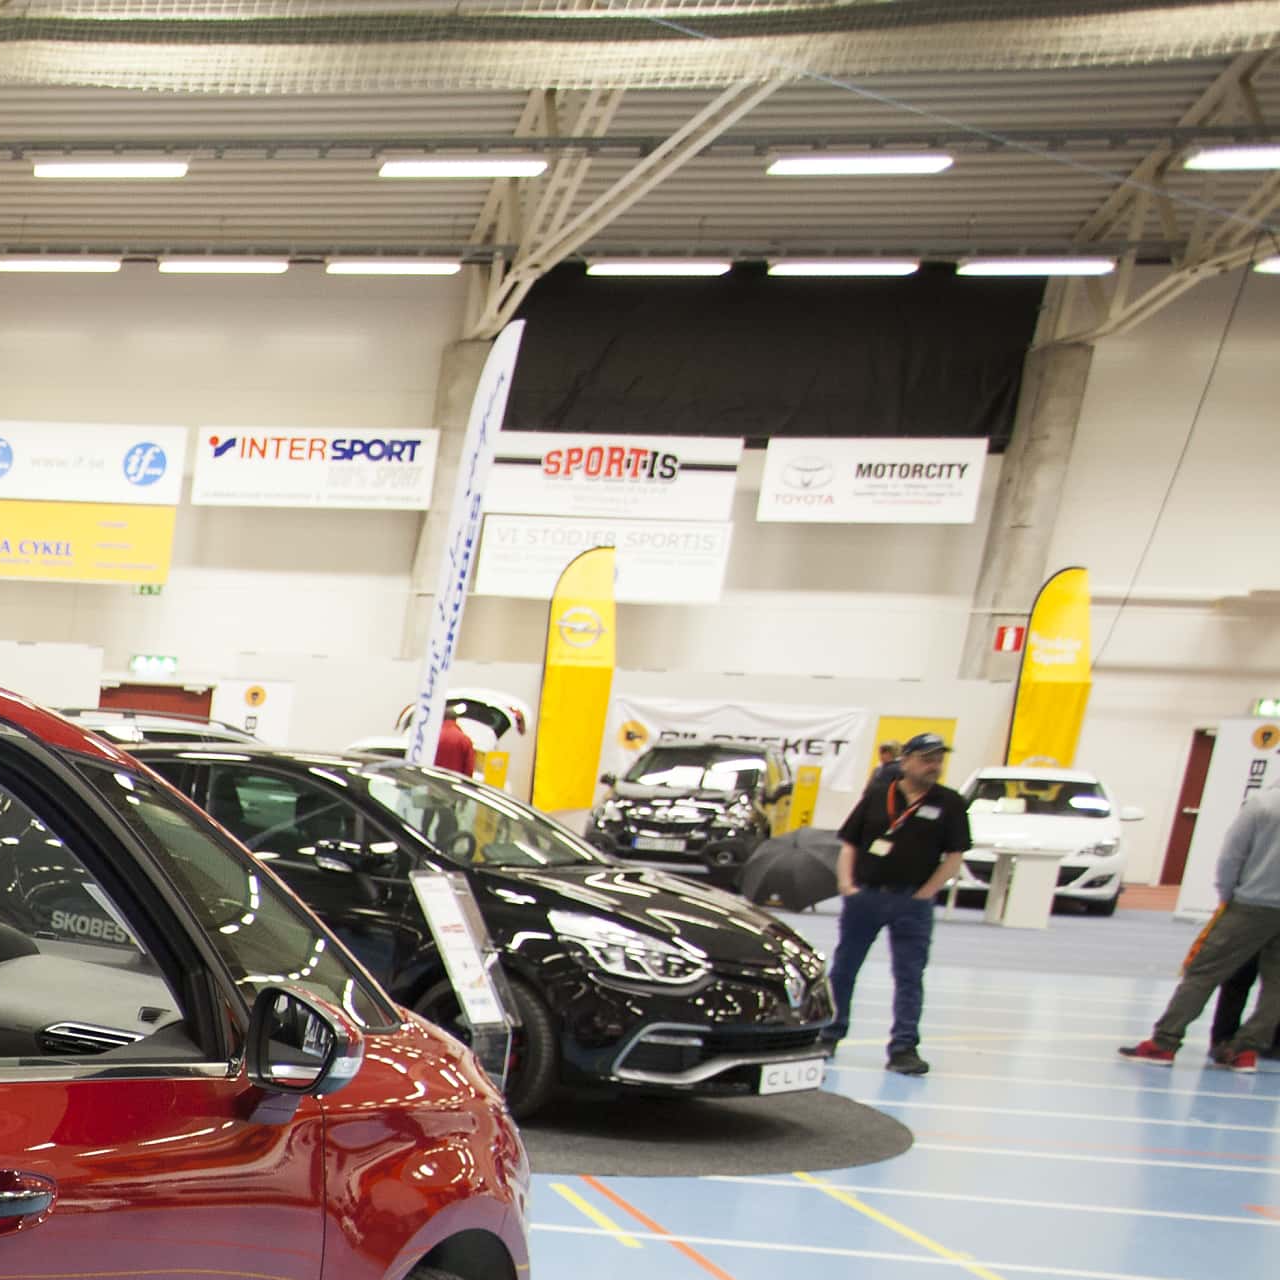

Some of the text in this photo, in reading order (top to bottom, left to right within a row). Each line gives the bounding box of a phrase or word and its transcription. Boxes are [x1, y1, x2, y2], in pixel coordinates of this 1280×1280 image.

[239, 436, 423, 463] INTERSPORT
[543, 445, 681, 481] SPORTIS
[855, 461, 970, 481] MOTORCITY
[773, 493, 835, 505] TOYOTA
[18, 540, 73, 557] CYKEL
[625, 531, 715, 552] SPORTIS
[51, 909, 128, 943] SKOBES
[767, 1066, 818, 1086] CLIO
